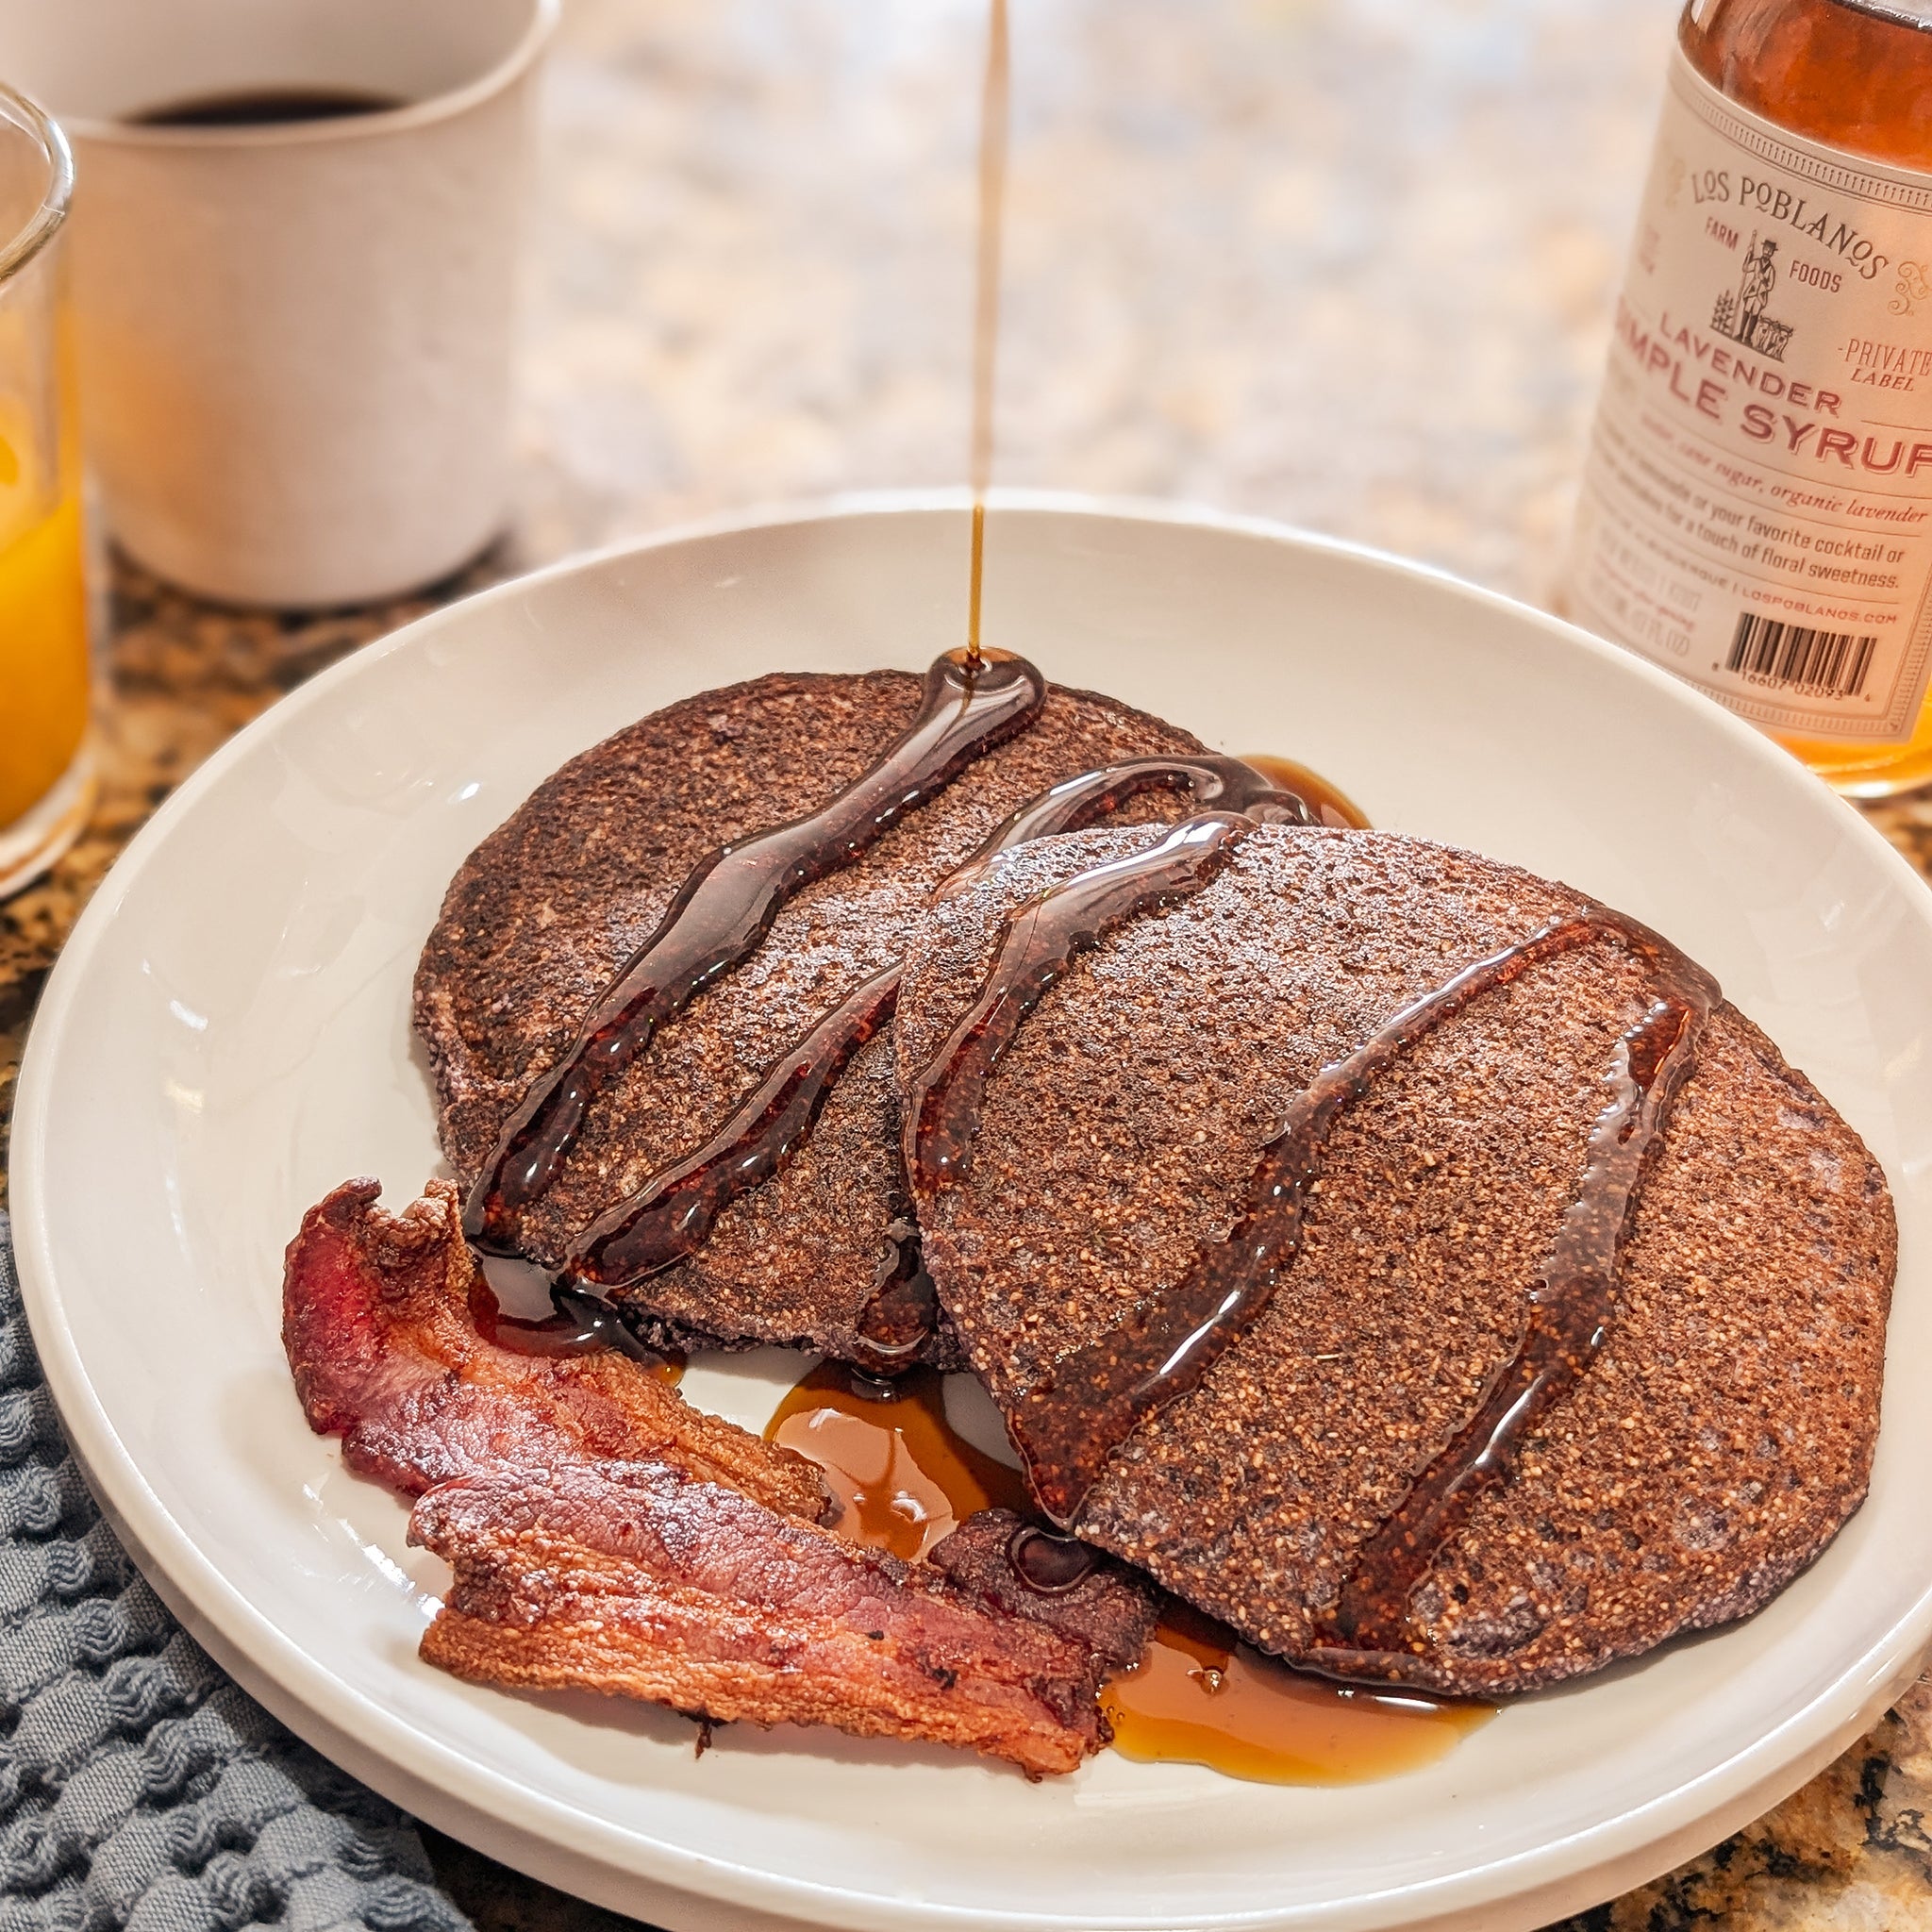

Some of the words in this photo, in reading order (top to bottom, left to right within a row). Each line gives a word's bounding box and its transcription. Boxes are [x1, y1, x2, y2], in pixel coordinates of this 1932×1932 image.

[1691, 170, 1730, 205] LOS
[1739, 176, 1889, 280] POBLANOS
[1706, 217, 1739, 251] FARM
[1790, 259, 1841, 293] FOODS
[1660, 311, 1842, 418] LAVENDER
[1851, 368, 1915, 391] LABEL
[1715, 462, 1764, 492] sugar,
[1770, 484, 1842, 512] organic
[1846, 499, 1929, 523] lavender
[1697, 523, 1739, 554] touch
[1741, 543, 1758, 559] of
[1761, 548, 1806, 574] floral
[1807, 564, 1900, 590] sweetness.
[1710, 505, 1744, 526] your
[1747, 515, 1811, 549] favorite
[1814, 540, 1884, 562] cocktail
[1886, 549, 1906, 563] or
[1742, 587, 1897, 625] LOSPOBLANOS.COM
